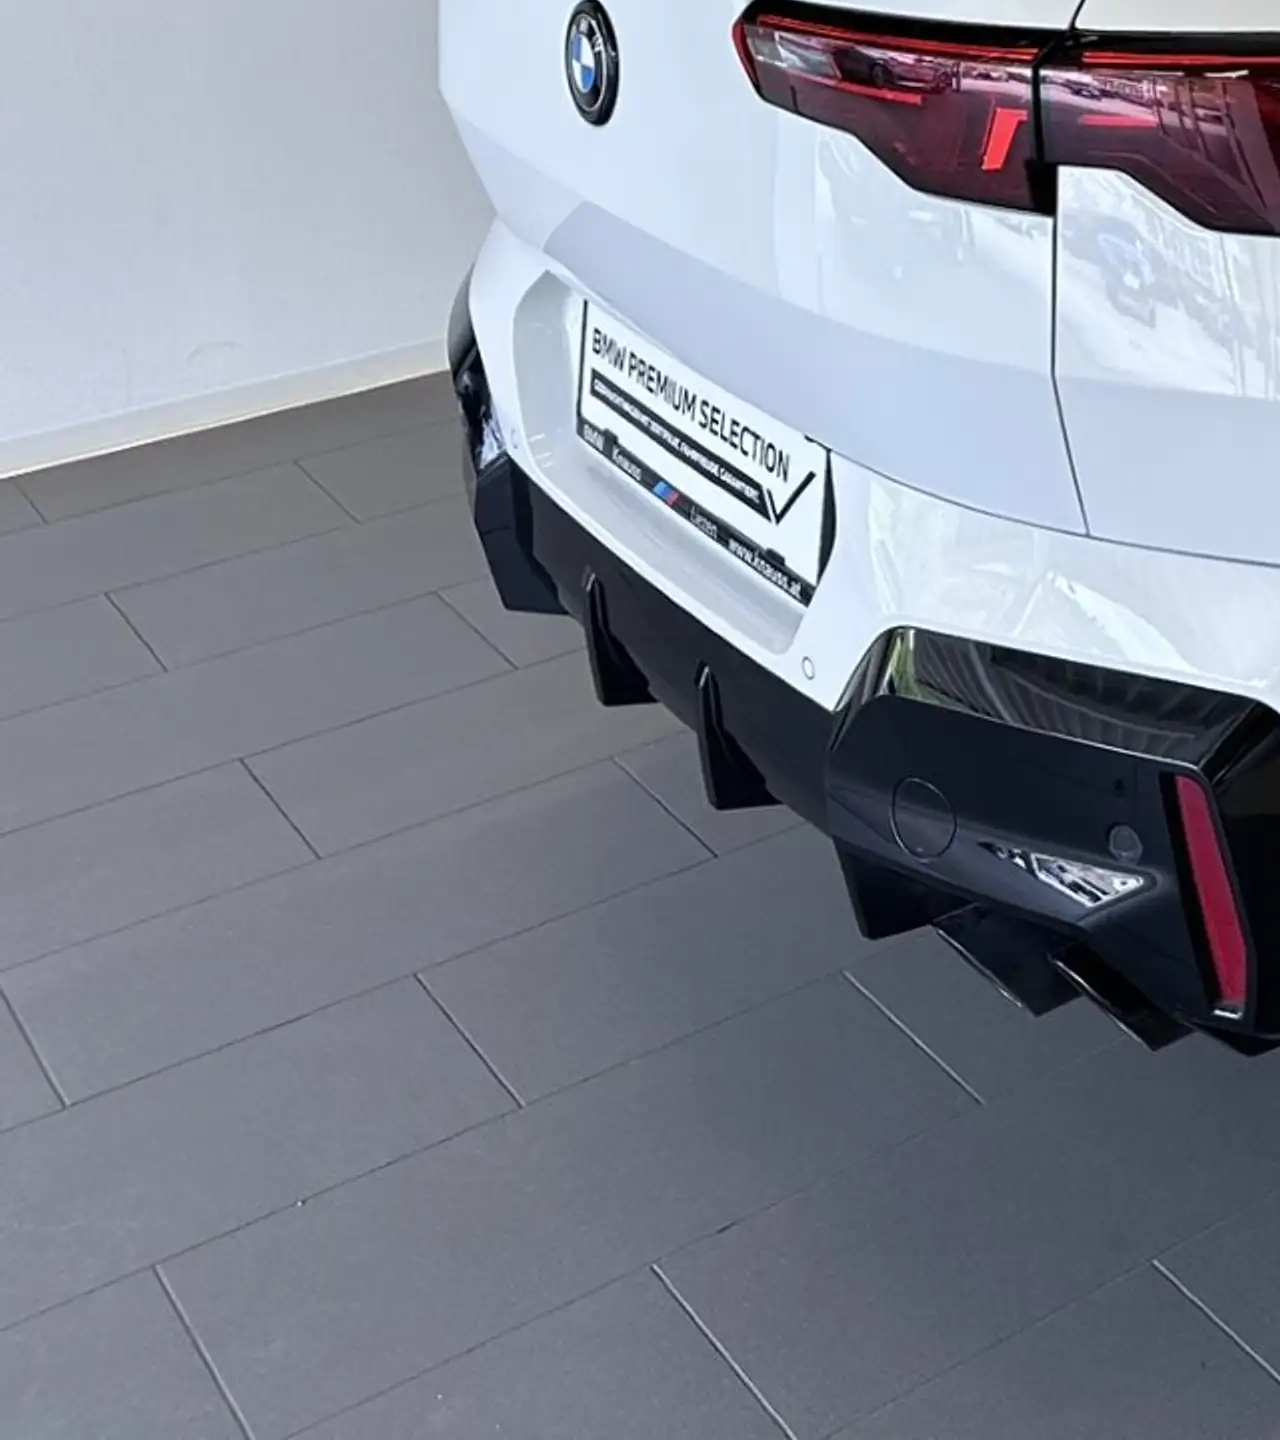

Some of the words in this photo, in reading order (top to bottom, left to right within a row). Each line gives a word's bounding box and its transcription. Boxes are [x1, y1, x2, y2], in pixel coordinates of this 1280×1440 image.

[592, 327, 627, 373] BMW
[628, 350, 697, 422] PREMIUM
[698, 399, 790, 483] SELECTION
